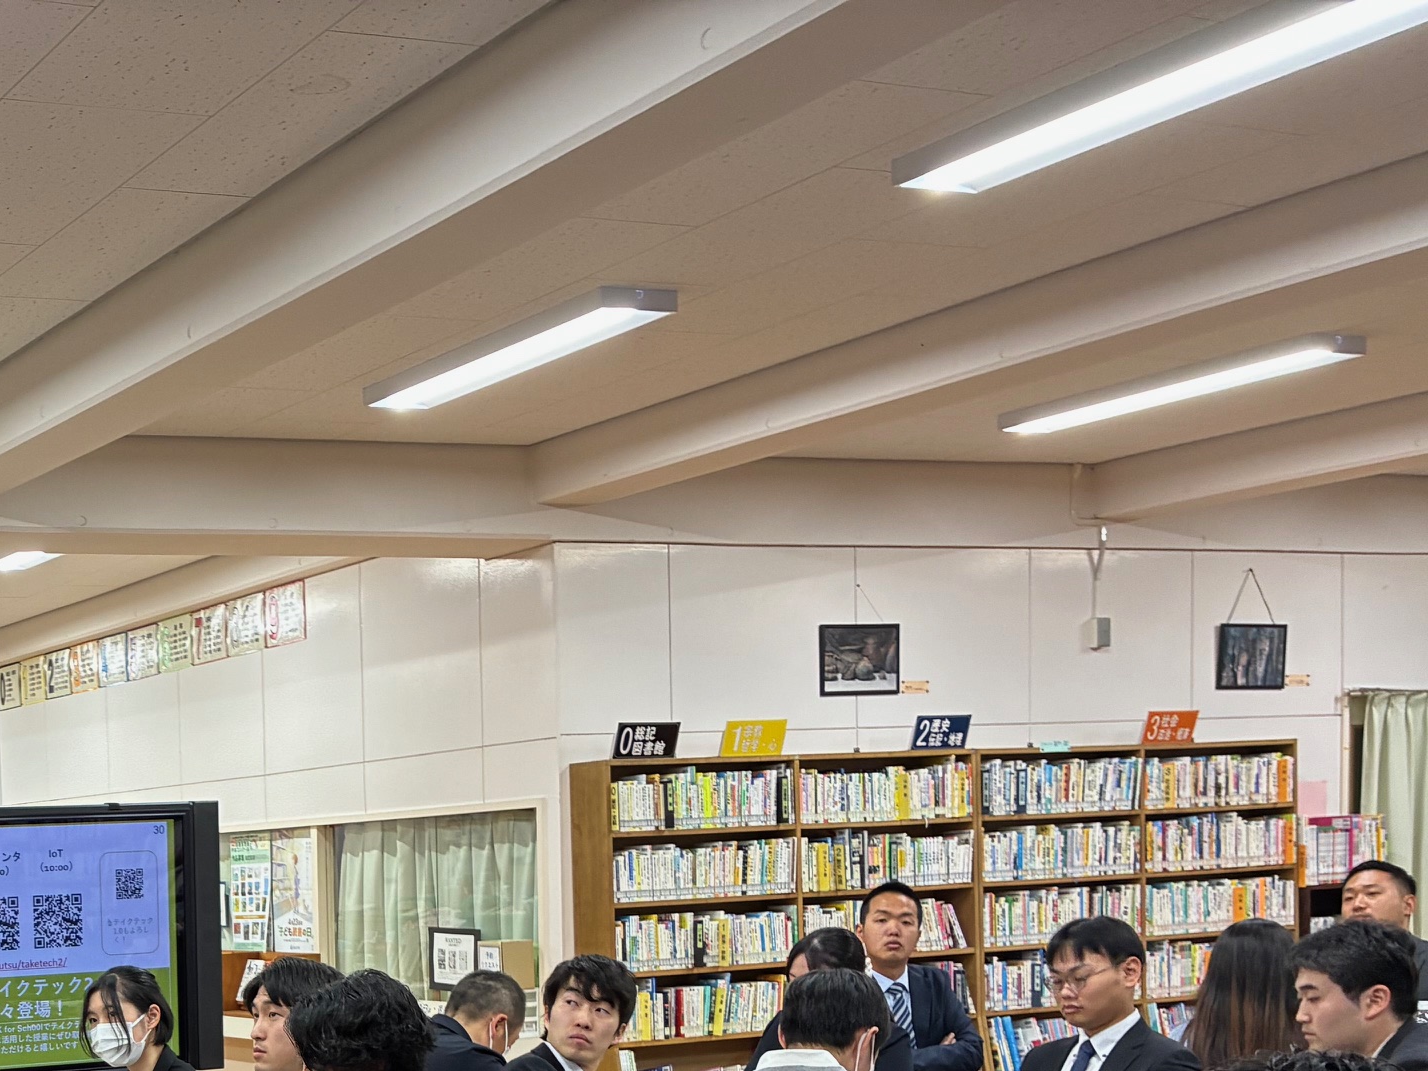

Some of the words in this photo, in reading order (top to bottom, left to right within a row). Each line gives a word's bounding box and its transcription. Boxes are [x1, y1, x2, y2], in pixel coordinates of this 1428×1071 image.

[634, 725, 657, 741] 総記
[916, 719, 930, 747] 2
[930, 718, 951, 732] 歴史
[1147, 715, 1160, 740] 3
[619, 726, 634, 755] 0
[732, 726, 743, 753] 1
[631, 740, 667, 756] 図書館
[153, 824, 165, 834] 30
[48, 848, 64, 858] IoT
